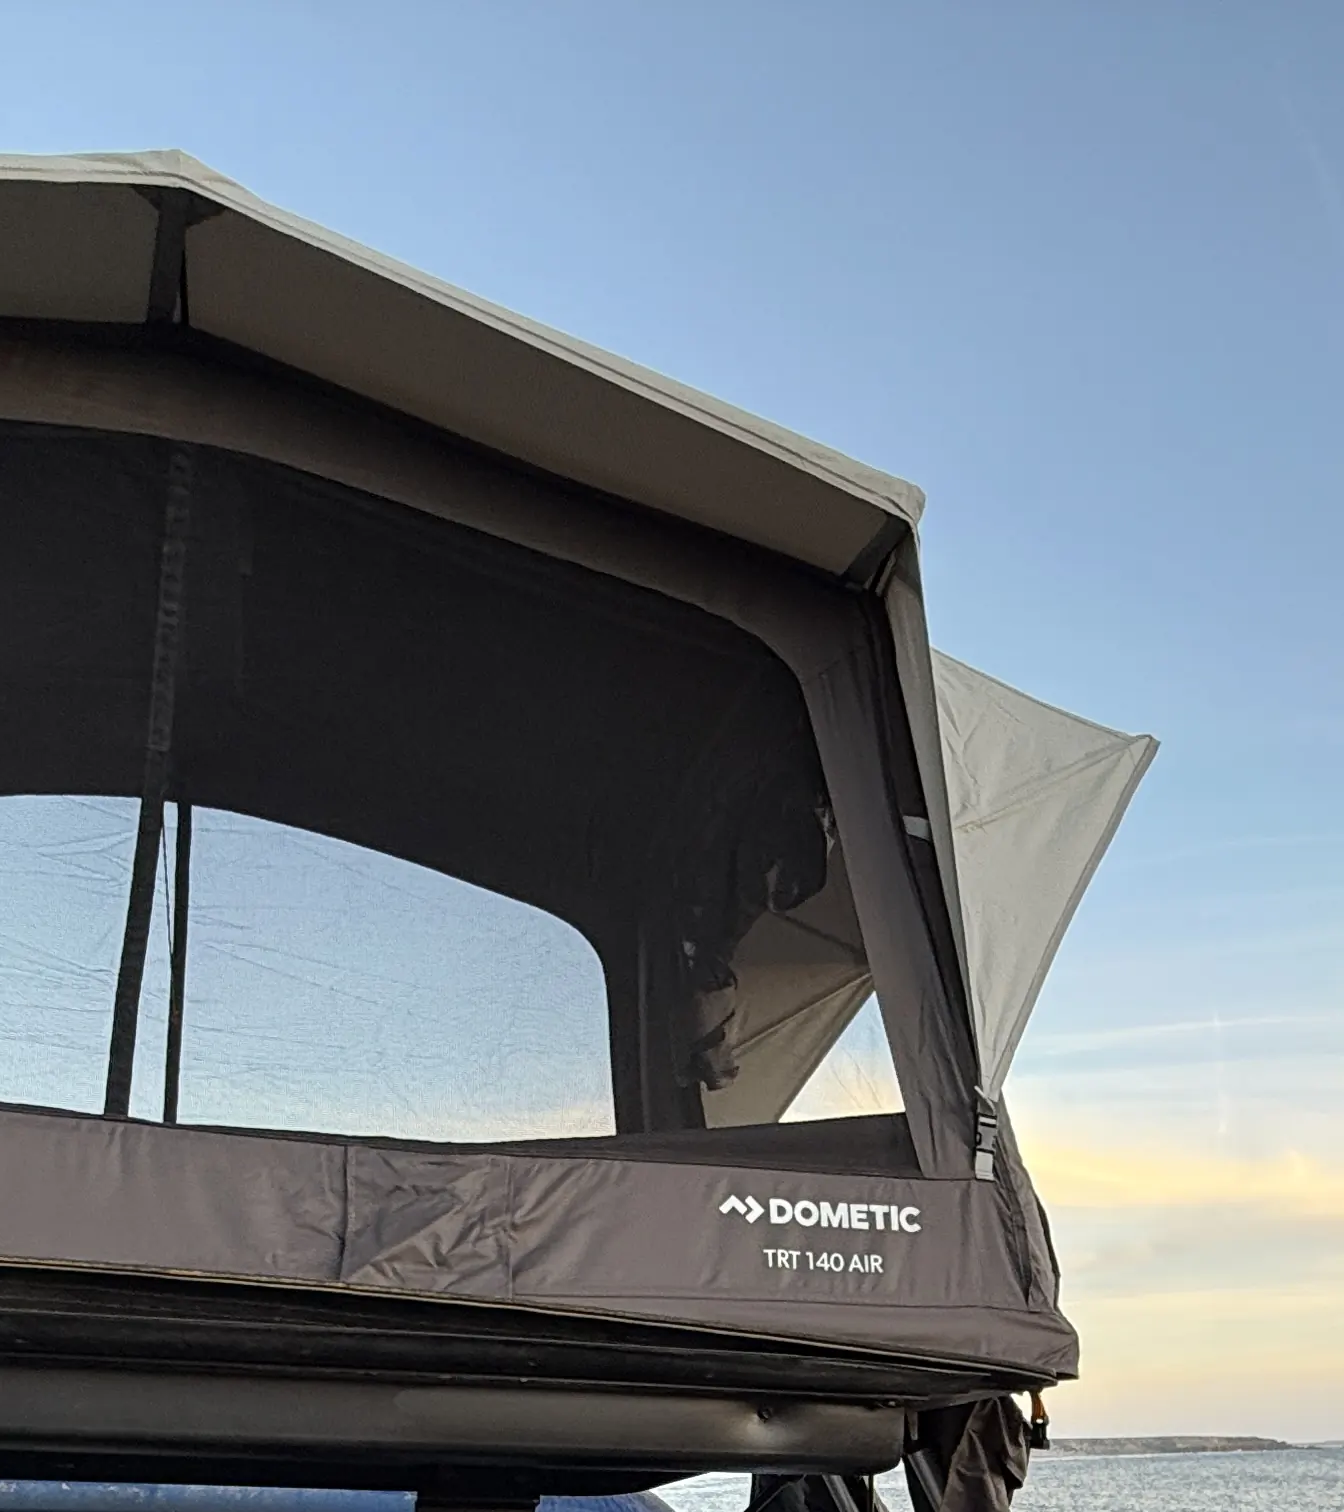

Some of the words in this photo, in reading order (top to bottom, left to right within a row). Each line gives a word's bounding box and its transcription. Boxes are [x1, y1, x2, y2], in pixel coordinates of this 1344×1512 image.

[770, 1198, 922, 1233] DOMETIC
[763, 1249, 801, 1270] TRT
[806, 1251, 844, 1272] 140
[848, 1253, 884, 1274] AIR
